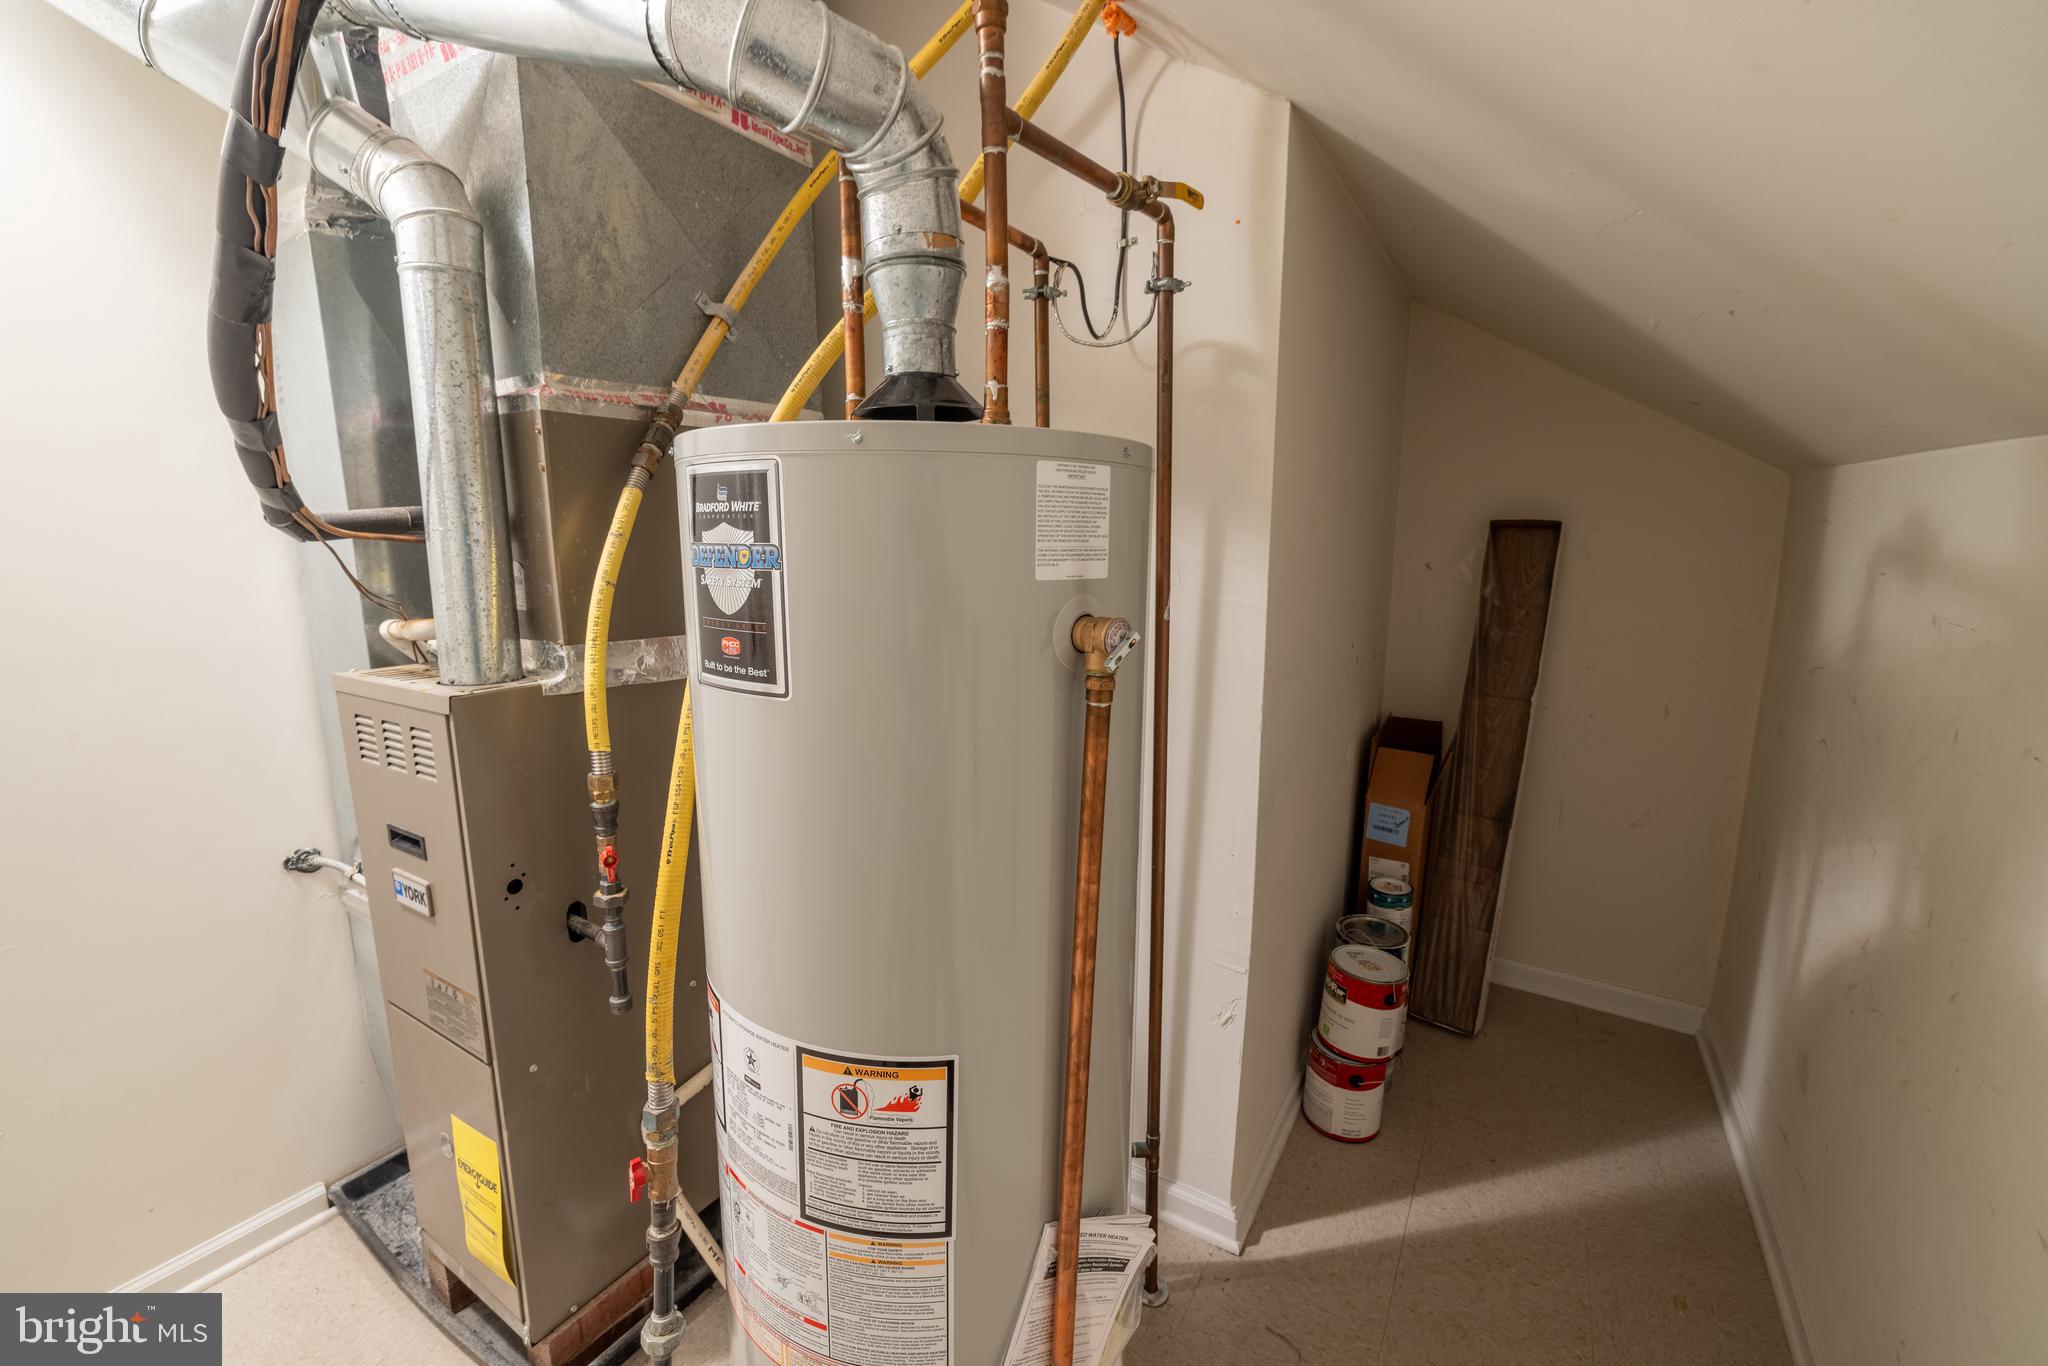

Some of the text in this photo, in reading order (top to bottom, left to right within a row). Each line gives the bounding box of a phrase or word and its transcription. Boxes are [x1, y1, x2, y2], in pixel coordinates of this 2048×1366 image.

[696, 501, 760, 512] BRADFORD WHITE
[692, 543, 781, 570] DEFENDER
[701, 574, 760, 588] SAFETY SYSTEM
[705, 660, 767, 677] Built to be the Best
[402, 885, 427, 907] YORK
[854, 1068, 899, 1079] WARNING
